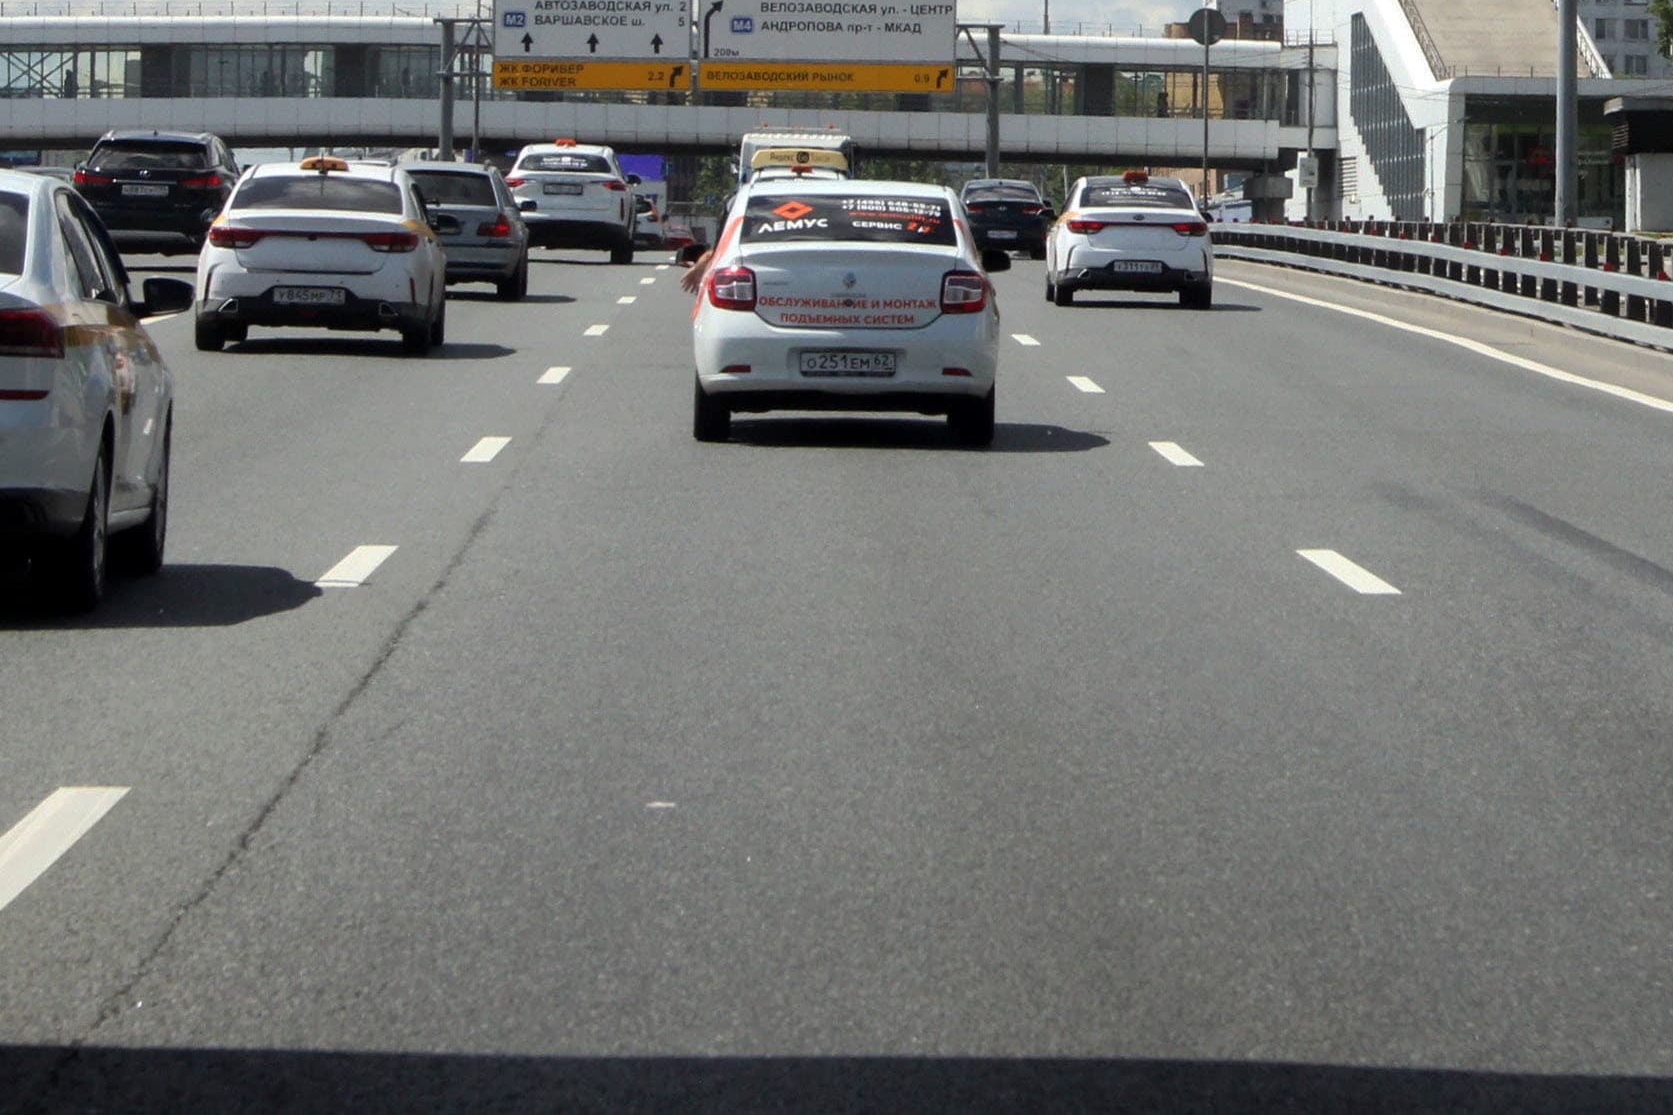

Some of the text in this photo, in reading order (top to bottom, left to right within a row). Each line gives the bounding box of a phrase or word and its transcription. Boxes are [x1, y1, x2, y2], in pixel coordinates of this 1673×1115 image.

[534, 0, 687, 14] АВТОЗАВОДСКАЯ ул. 2
[760, 1, 877, 15] ВЕЛОЗАВОДСКАЯ
[880, 4, 899, 17] ул.
[910, 3, 953, 16] ЦЕНТР
[534, 14, 686, 28] ВАРШАВСКОЕ ш. 5
[760, 20, 843, 33] АНДРОПОВА
[847, 23, 872, 35] пр-т
[884, 22, 922, 35] МКАД
[499, 63, 518, 74] ЖК
[706, 69, 809, 82] ВЕЛОЗАВОДСКИЙ
[812, 72, 854, 82] РЫНОК
[499, 77, 577, 88] ЖК FORIVER
[758, 218, 829, 234] ЛЕМУС
[852, 220, 903, 230] СЕРВИС
[758, 296, 868, 309] ОБСЛУЖИВАНИЕ
[871, 300, 880, 309] И
[883, 298, 937, 309] МОНТАЖ
[780, 312, 915, 325] ПОДЪЕМНЫХ СИСТЕМ
